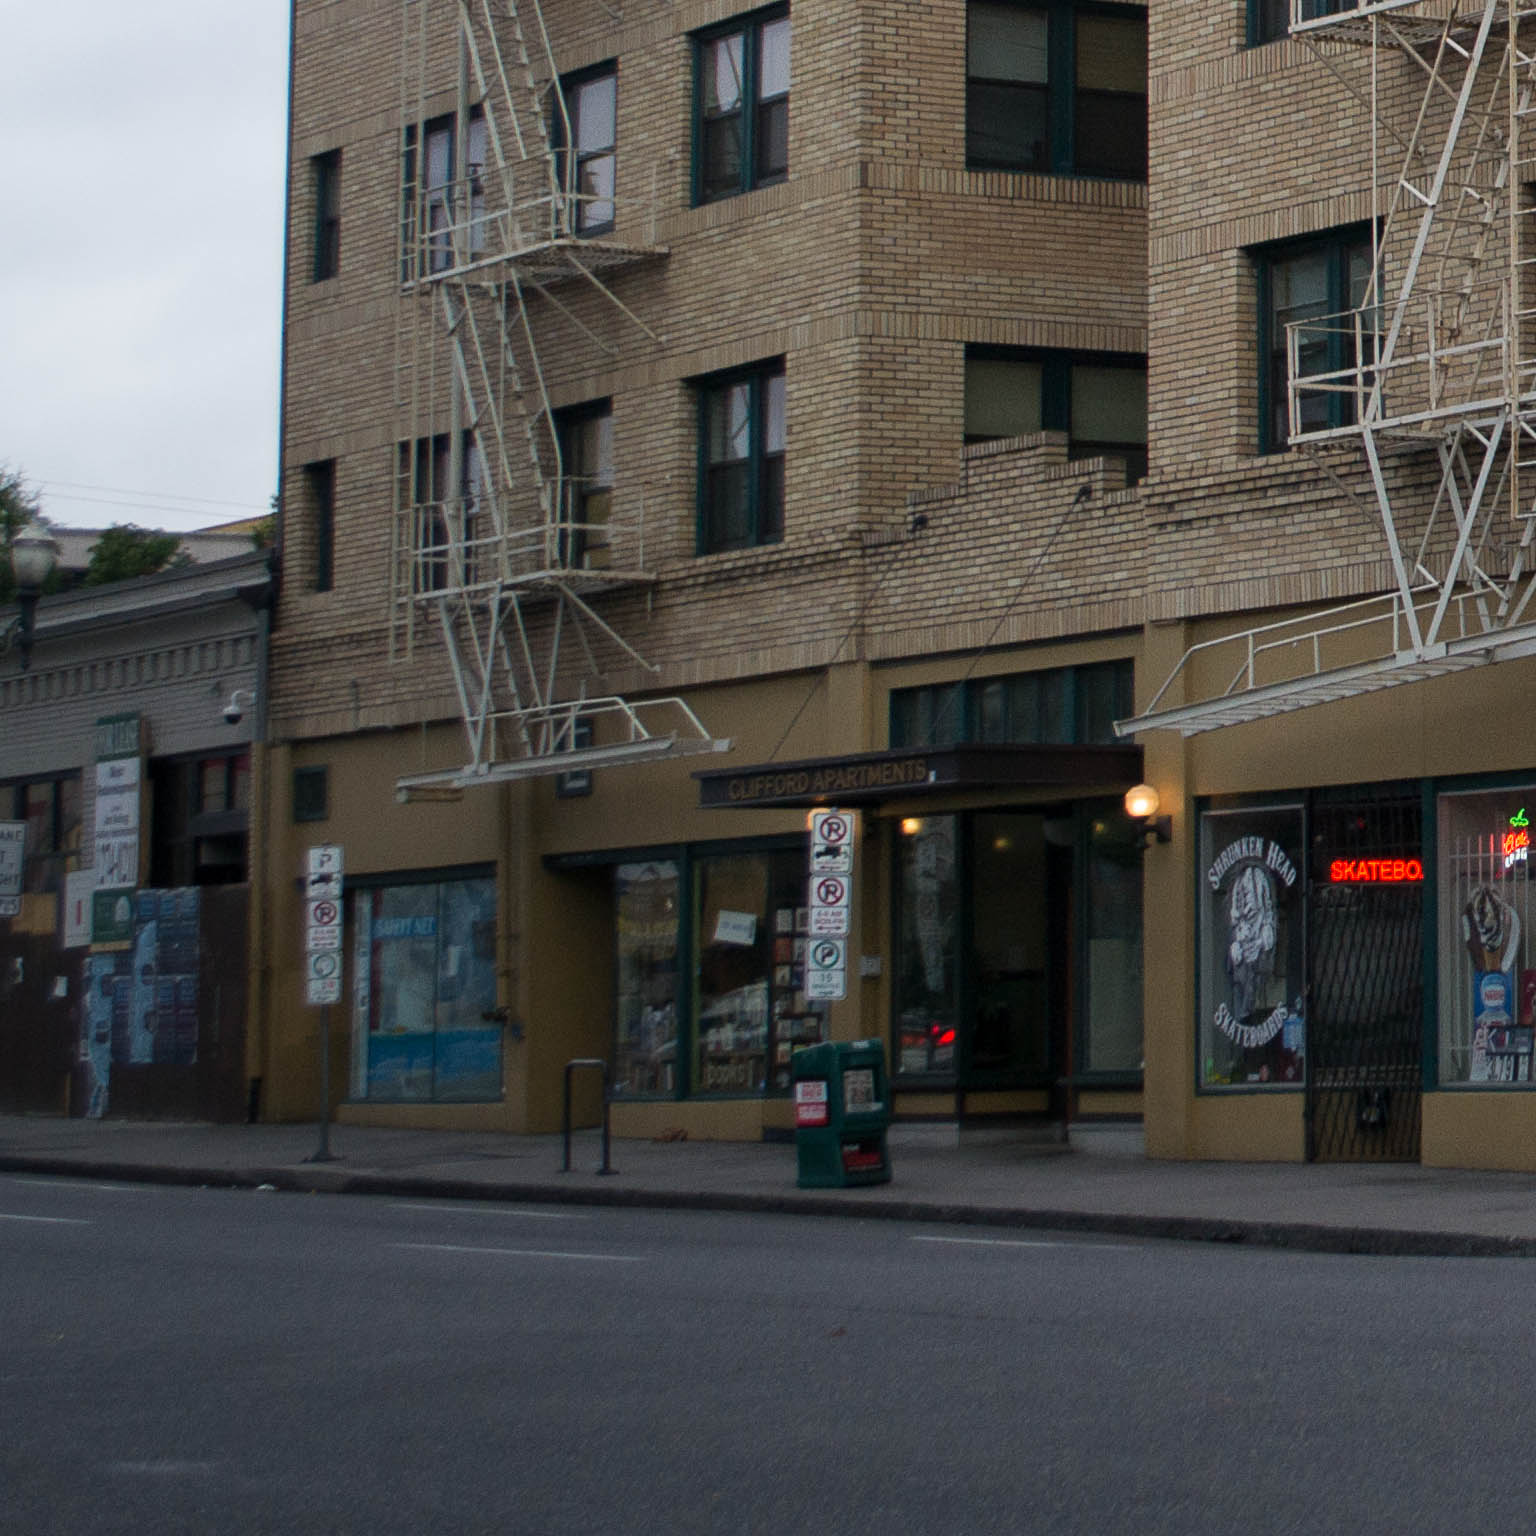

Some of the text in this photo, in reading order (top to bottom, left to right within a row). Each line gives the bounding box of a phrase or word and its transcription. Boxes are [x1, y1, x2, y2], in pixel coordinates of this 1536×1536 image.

[728, 760, 928, 801] CLIFFORD APARTMENTS
[1208, 836, 1297, 889] SHRUNKEN HEAD
[1330, 859, 1424, 882] SKATEBO
[1214, 1001, 1288, 1048] SKATEBOARDS
